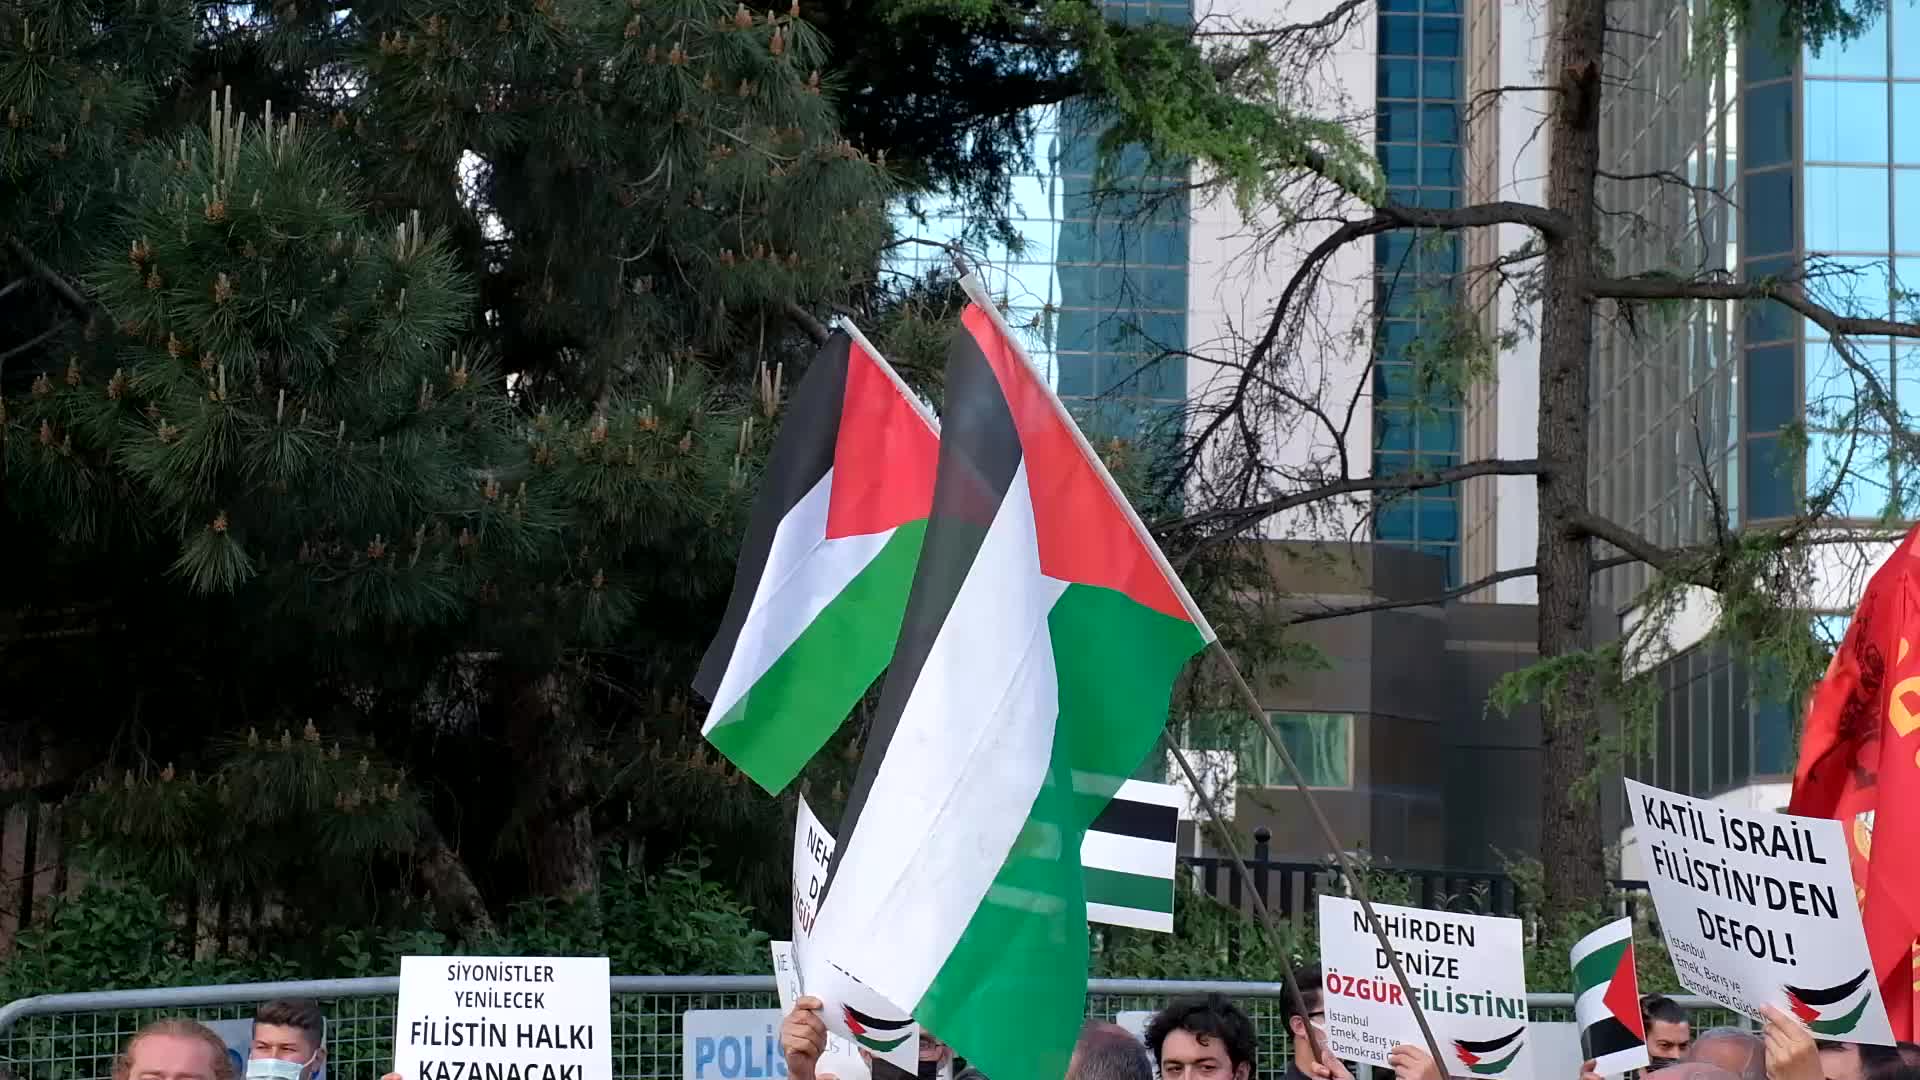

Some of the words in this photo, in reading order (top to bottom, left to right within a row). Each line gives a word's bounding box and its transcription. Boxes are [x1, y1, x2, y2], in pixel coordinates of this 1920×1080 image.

[1641, 794, 1715, 845] KATİL
[1718, 808, 1827, 865] İSRAİL
[1697, 907, 1797, 966] DEFOL!
[447, 960, 554, 983] SİYONİSTLER
[1326, 967, 1404, 1006] ÖZGÜR
[455, 987, 546, 1009] YENİLECEK
[410, 1015, 507, 1048] FİLİSTİN
[516, 1023, 593, 1050] HALKI
[1332, 1040, 1384, 1061] Demokrasi
